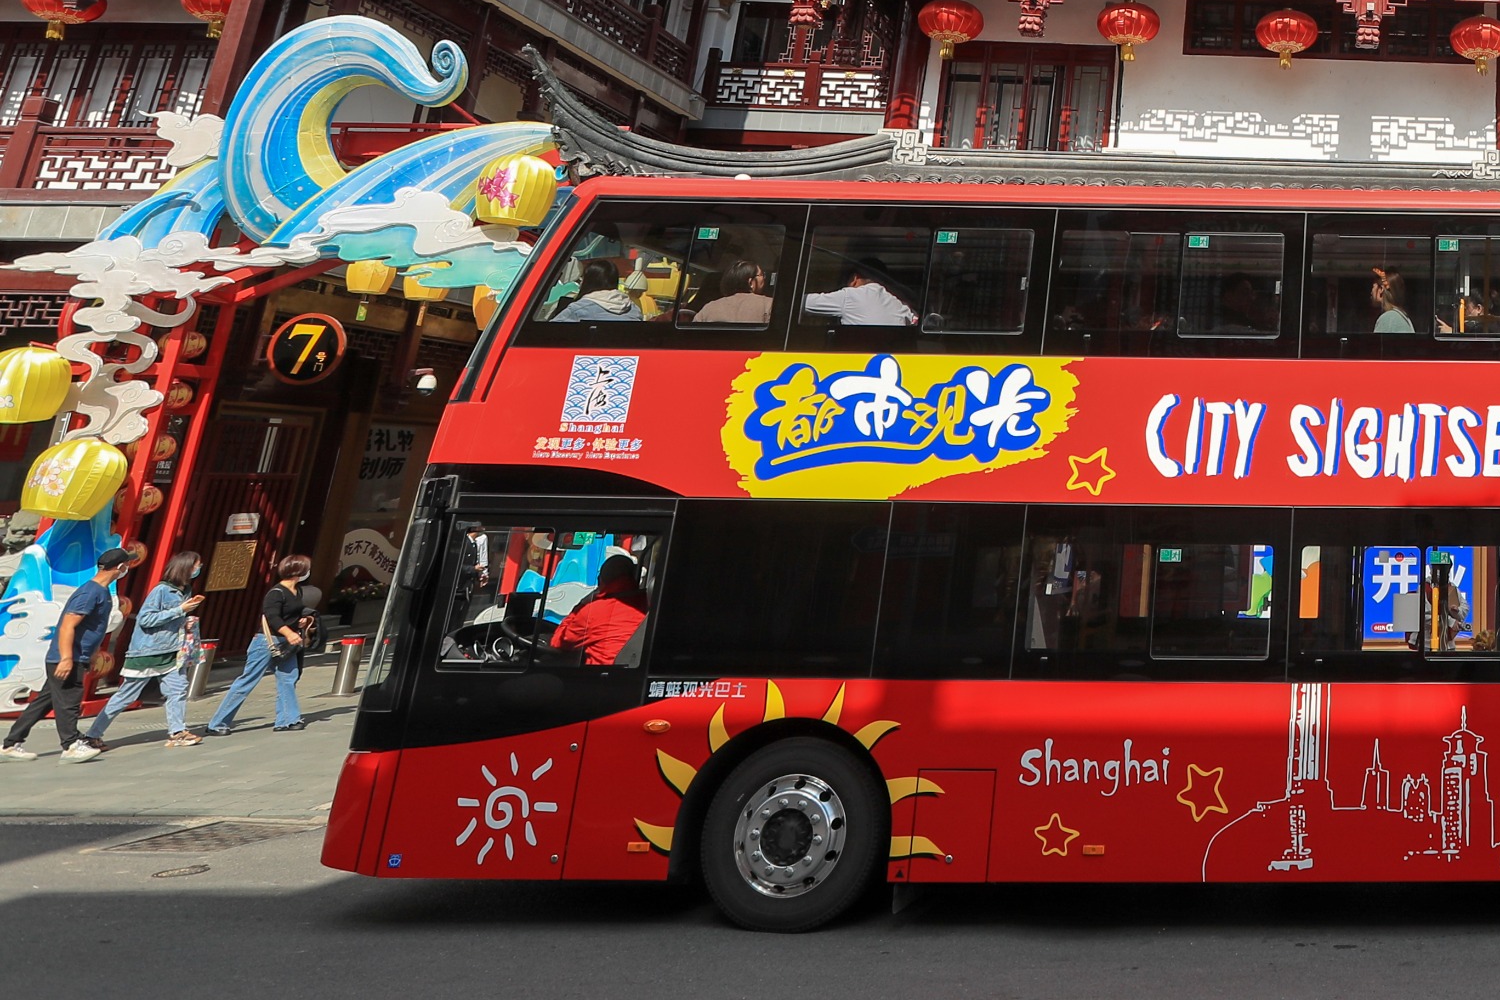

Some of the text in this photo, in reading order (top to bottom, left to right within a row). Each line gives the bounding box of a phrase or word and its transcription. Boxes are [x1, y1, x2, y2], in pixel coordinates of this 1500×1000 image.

[288, 323, 327, 375] 7 号门
[586, 366, 615, 415] 上海
[760, 357, 1047, 453] 都市观光
[559, 422, 625, 434] Shanghai
[1145, 394, 1264, 479] CITY
[648, 681, 747, 698] 蜻蜓观光巴士
[1018, 738, 1170, 797] Shanghai
